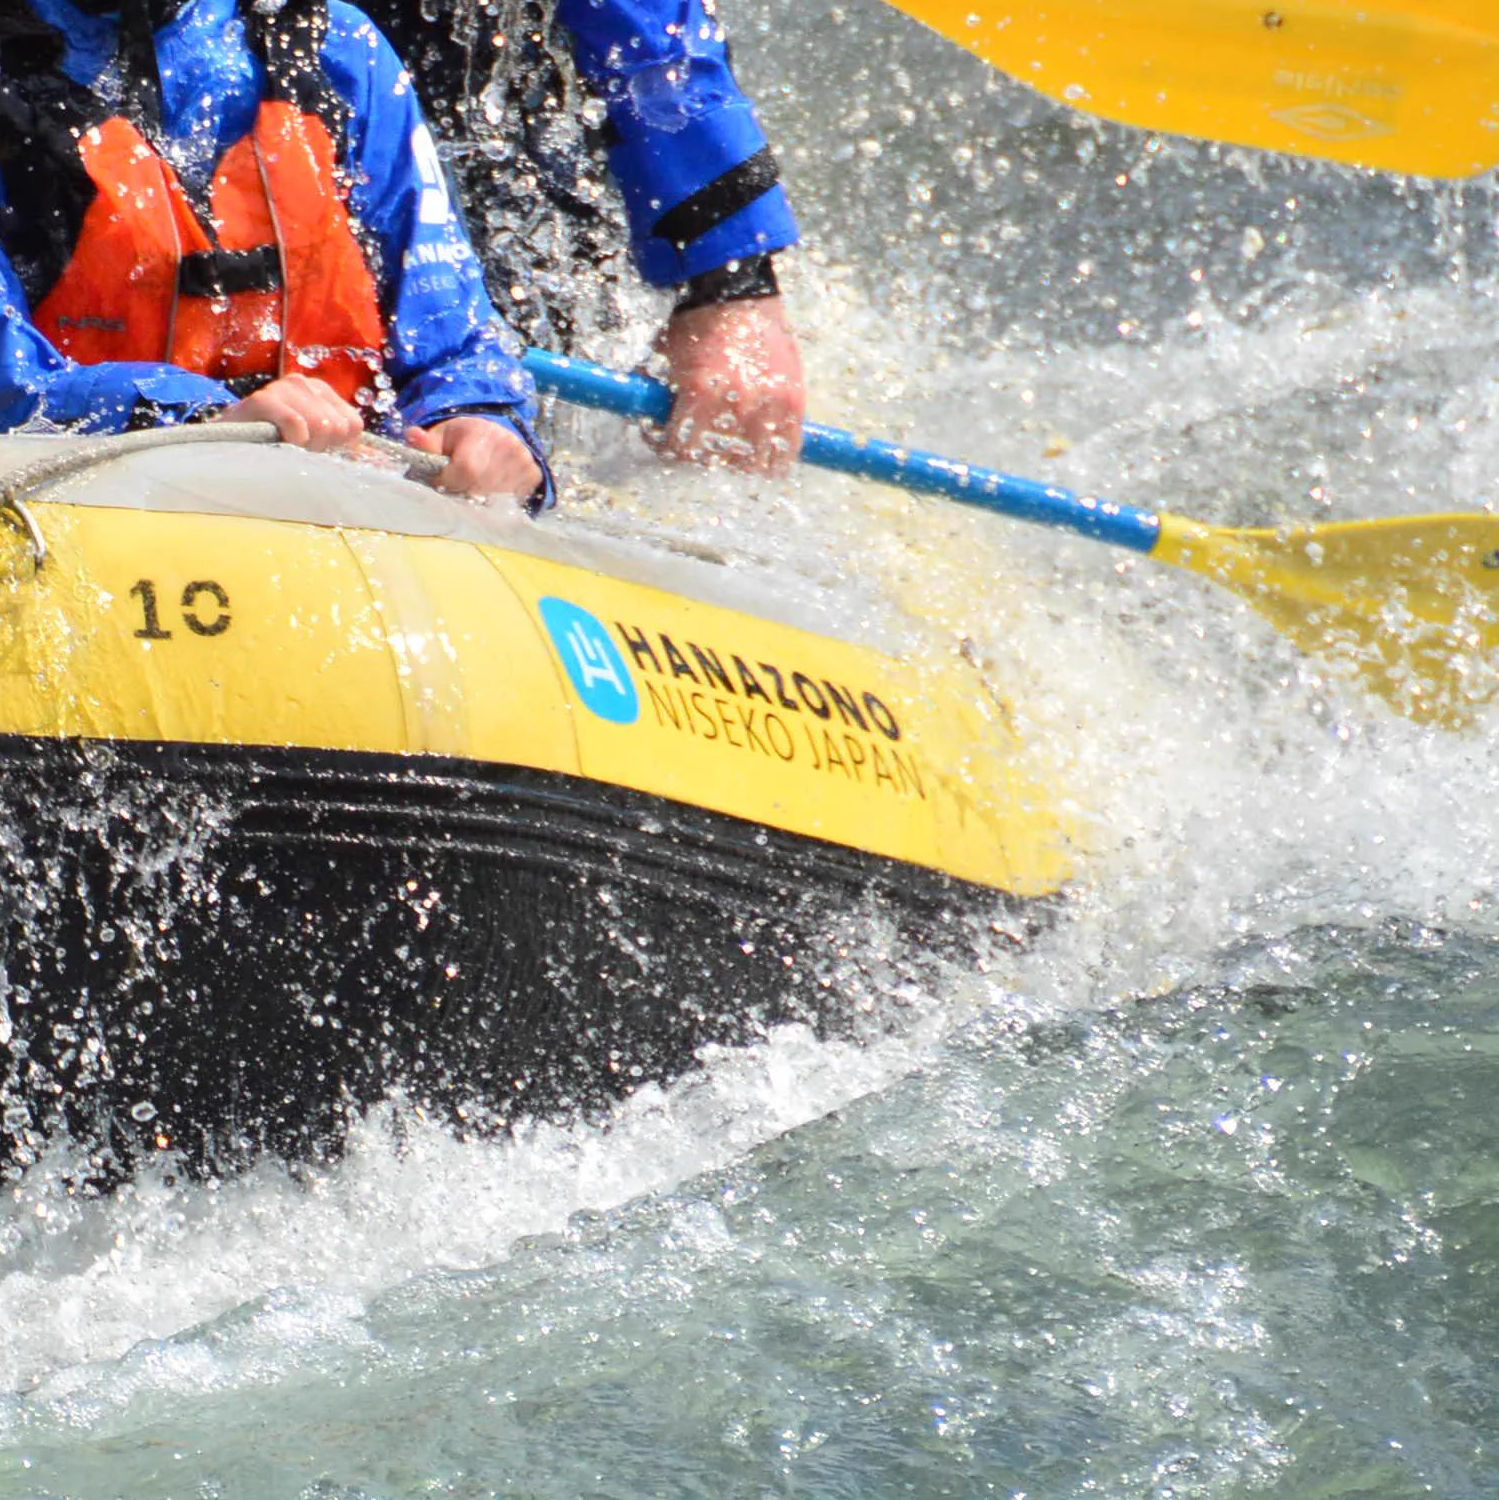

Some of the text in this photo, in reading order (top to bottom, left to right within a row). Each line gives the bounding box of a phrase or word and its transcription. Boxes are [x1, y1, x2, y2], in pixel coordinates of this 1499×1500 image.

[129, 578, 232, 640] 10
[614, 621, 901, 742] HANAZONO
[645, 680, 927, 801] NISEKO JAPAN
